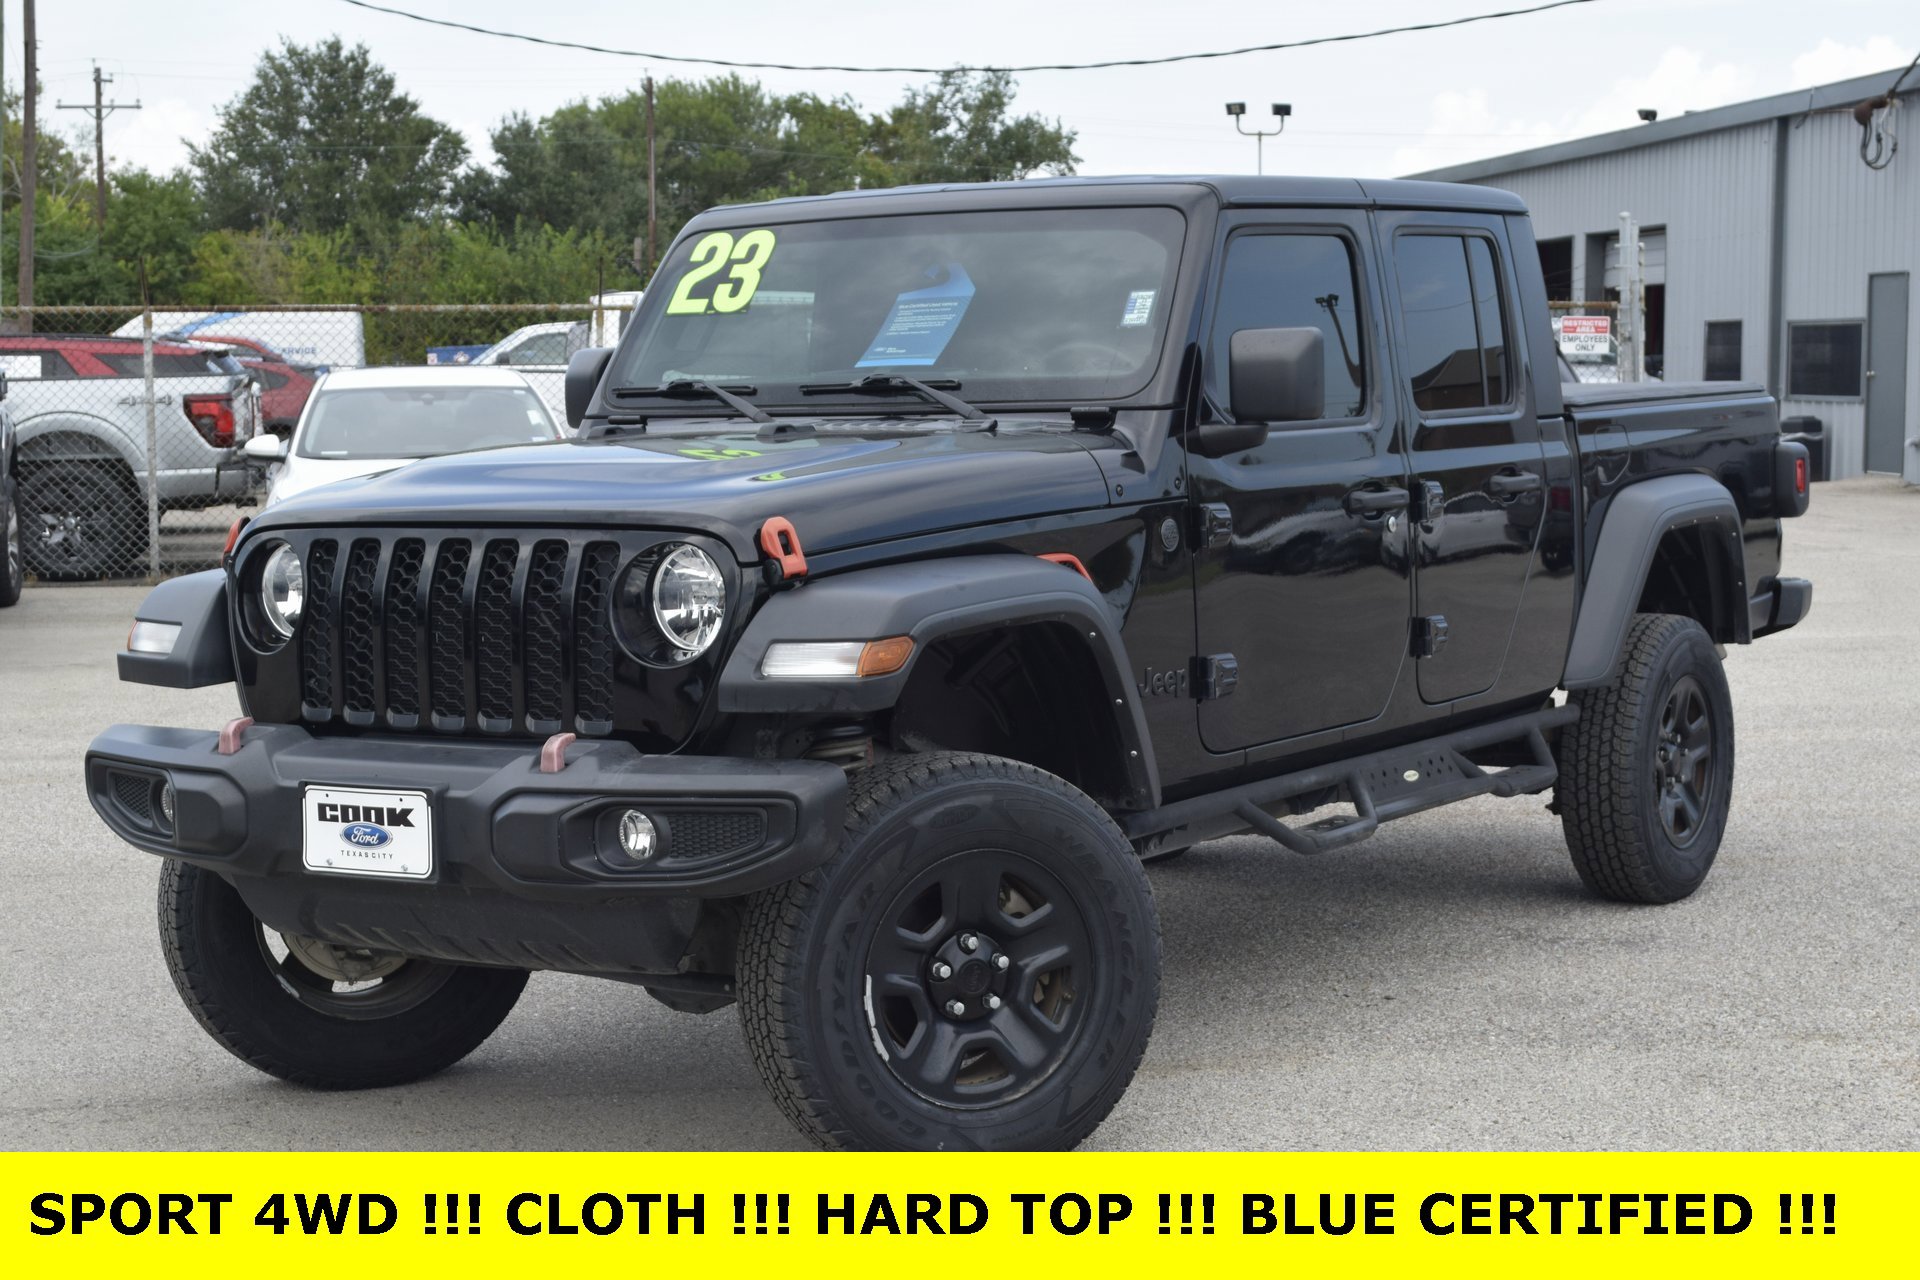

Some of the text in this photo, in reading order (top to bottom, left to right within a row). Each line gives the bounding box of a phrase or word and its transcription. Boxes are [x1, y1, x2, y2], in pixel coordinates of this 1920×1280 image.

[666, 229, 776, 315] 23
[1562, 319, 1609, 327] RESTRICTED
[1562, 335, 1609, 343] EMPLOYEES
[1137, 666, 1187, 698] Jeep
[317, 802, 416, 828] COOK
[351, 826, 380, 845] Ford
[830, 880, 928, 1138] GOODYEAR
